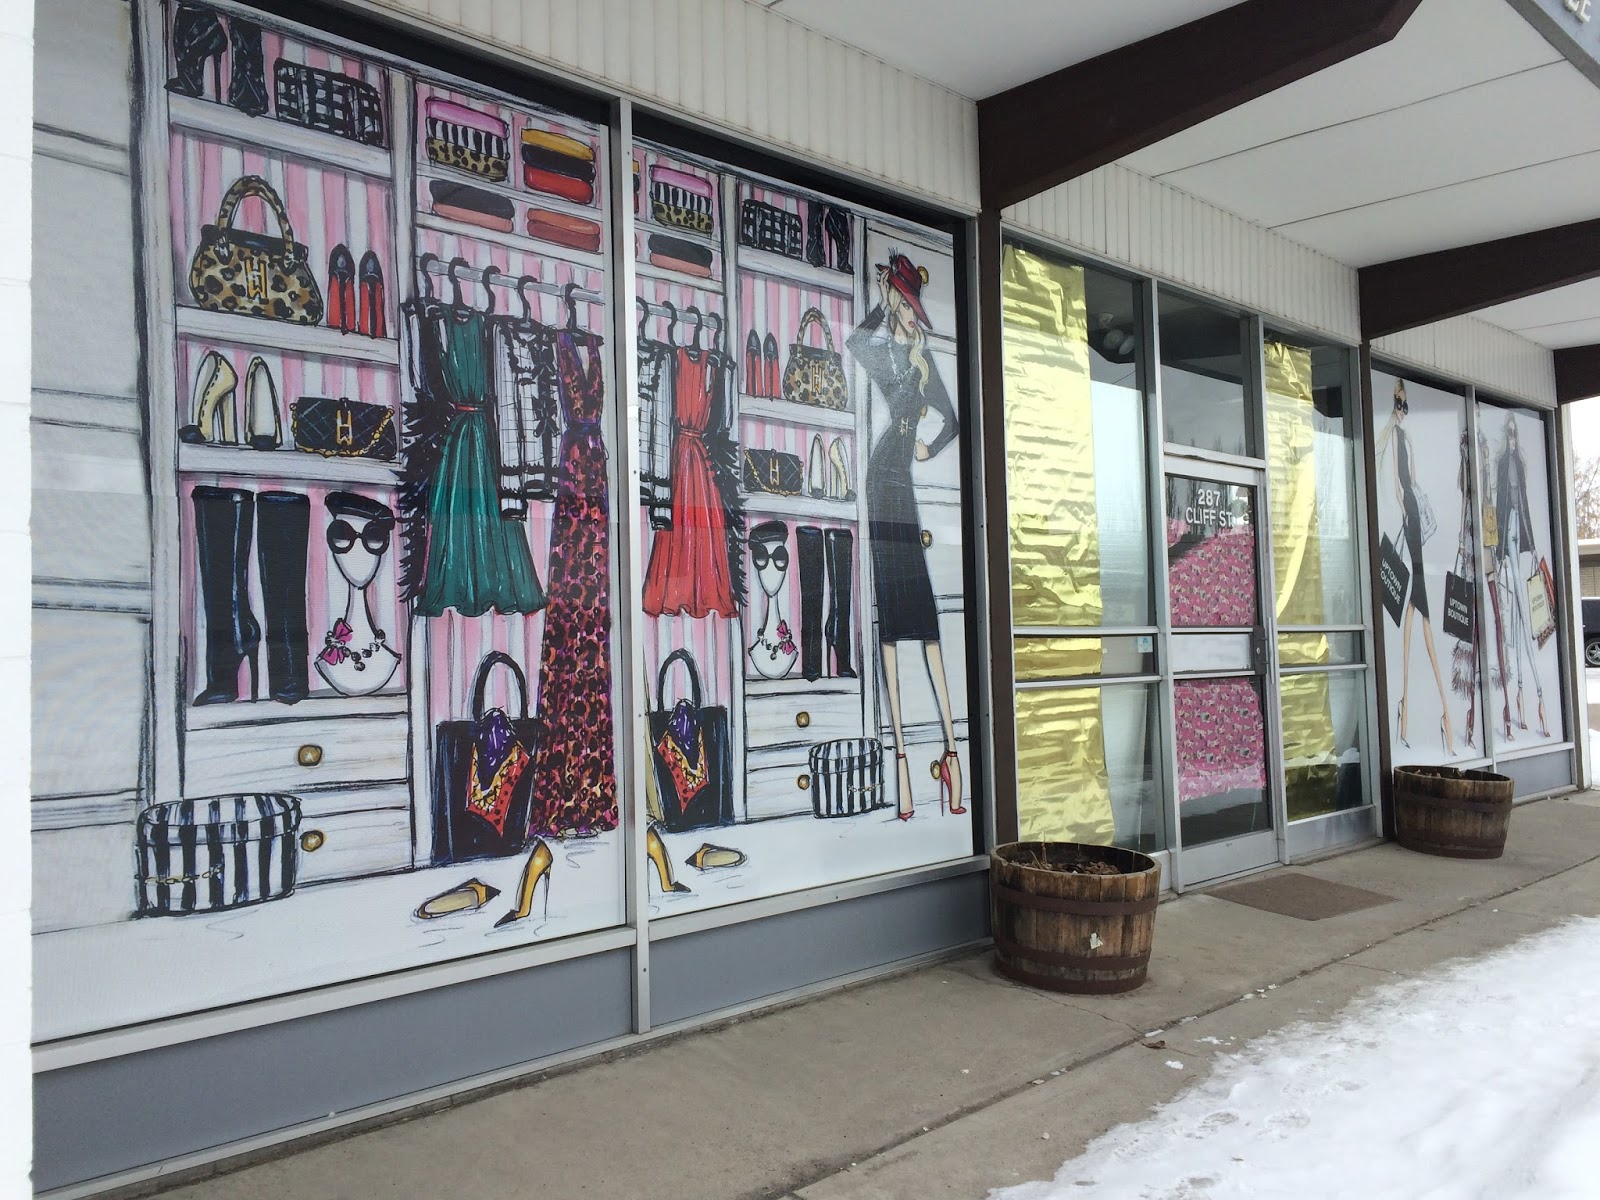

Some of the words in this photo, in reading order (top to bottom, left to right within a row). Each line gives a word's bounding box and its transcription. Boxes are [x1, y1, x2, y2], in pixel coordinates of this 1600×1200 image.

[1198, 488, 1220, 506] 287
[1186, 506, 1216, 525] CLIFF
[1382, 558, 1402, 592] UPTOWN
[1380, 567, 1401, 604] OUTIQUE
[1450, 597, 1467, 614] UPTOWN
[1448, 608, 1469, 626] BOUTIQUE
